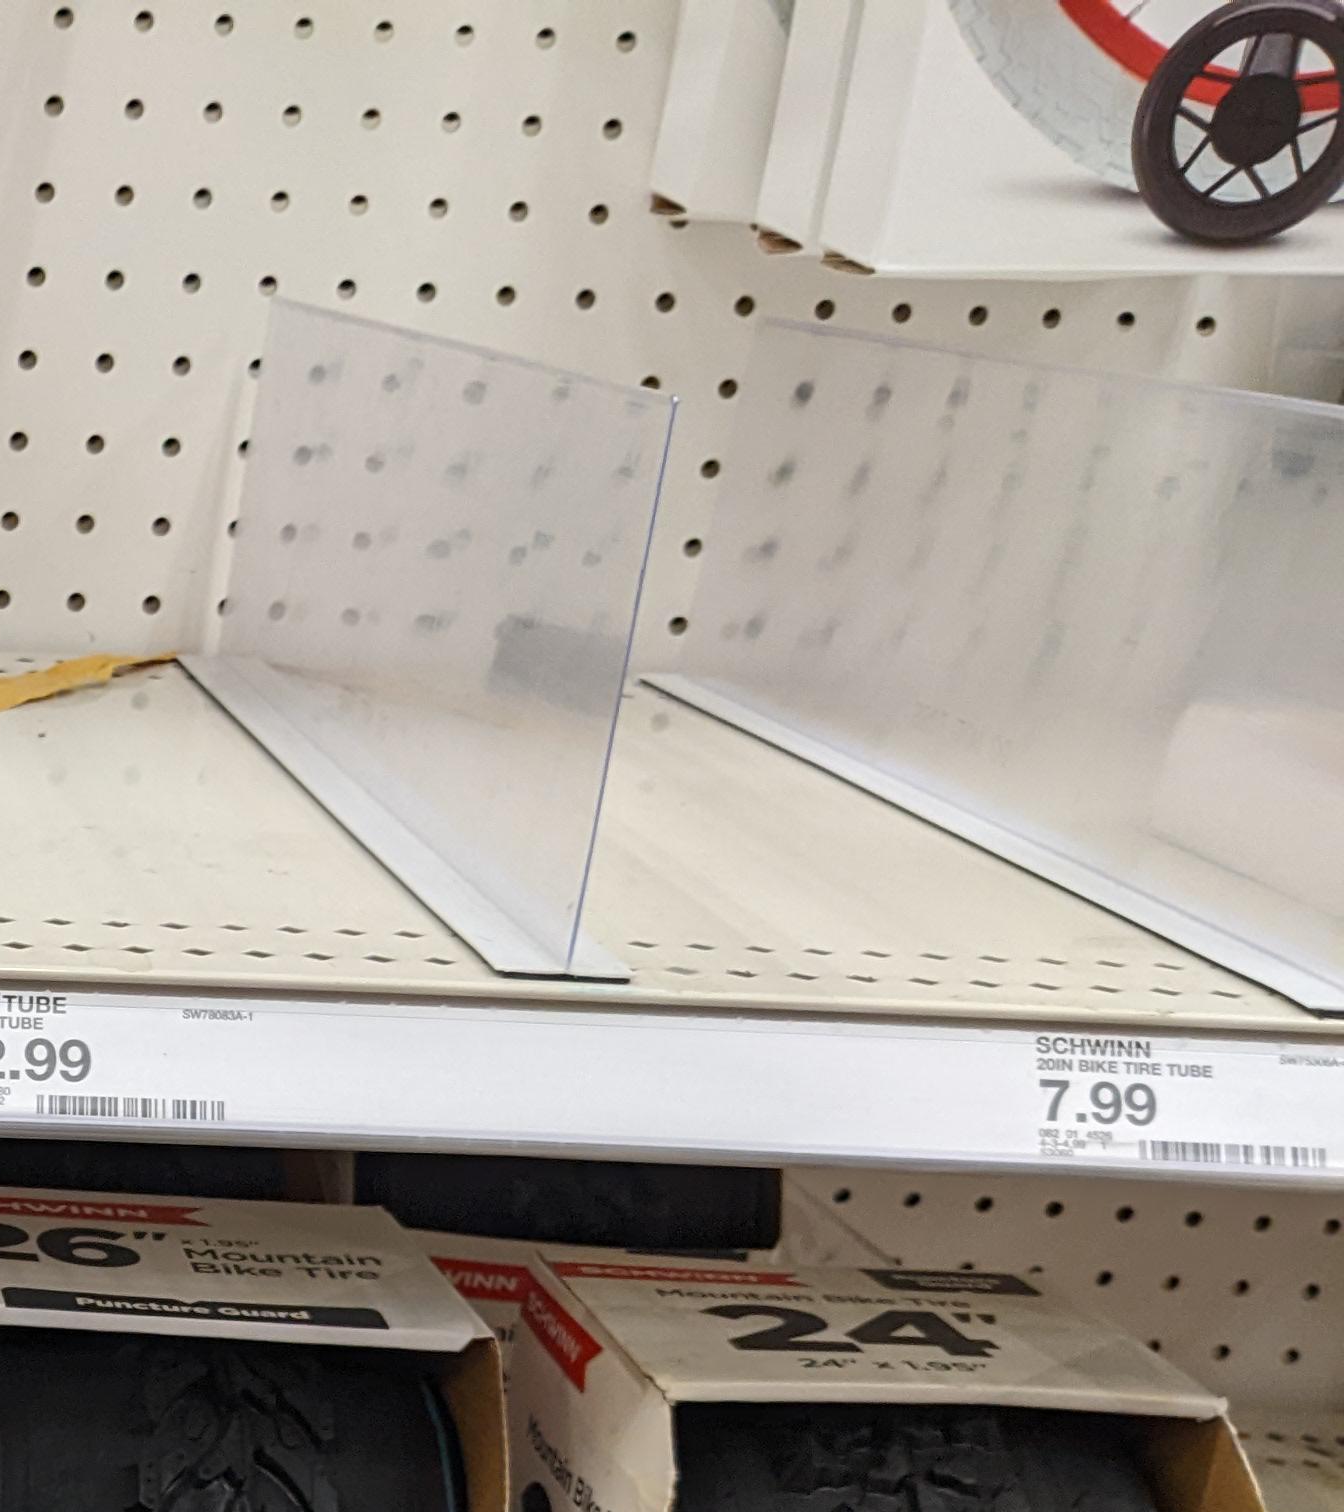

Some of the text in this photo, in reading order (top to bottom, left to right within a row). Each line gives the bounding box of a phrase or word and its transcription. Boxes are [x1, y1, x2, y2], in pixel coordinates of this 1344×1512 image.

[2, 995, 67, 1015] TUBE
[1035, 1036, 1152, 1058] SCHWINN
[1038, 1078, 1158, 1127] 7.99
